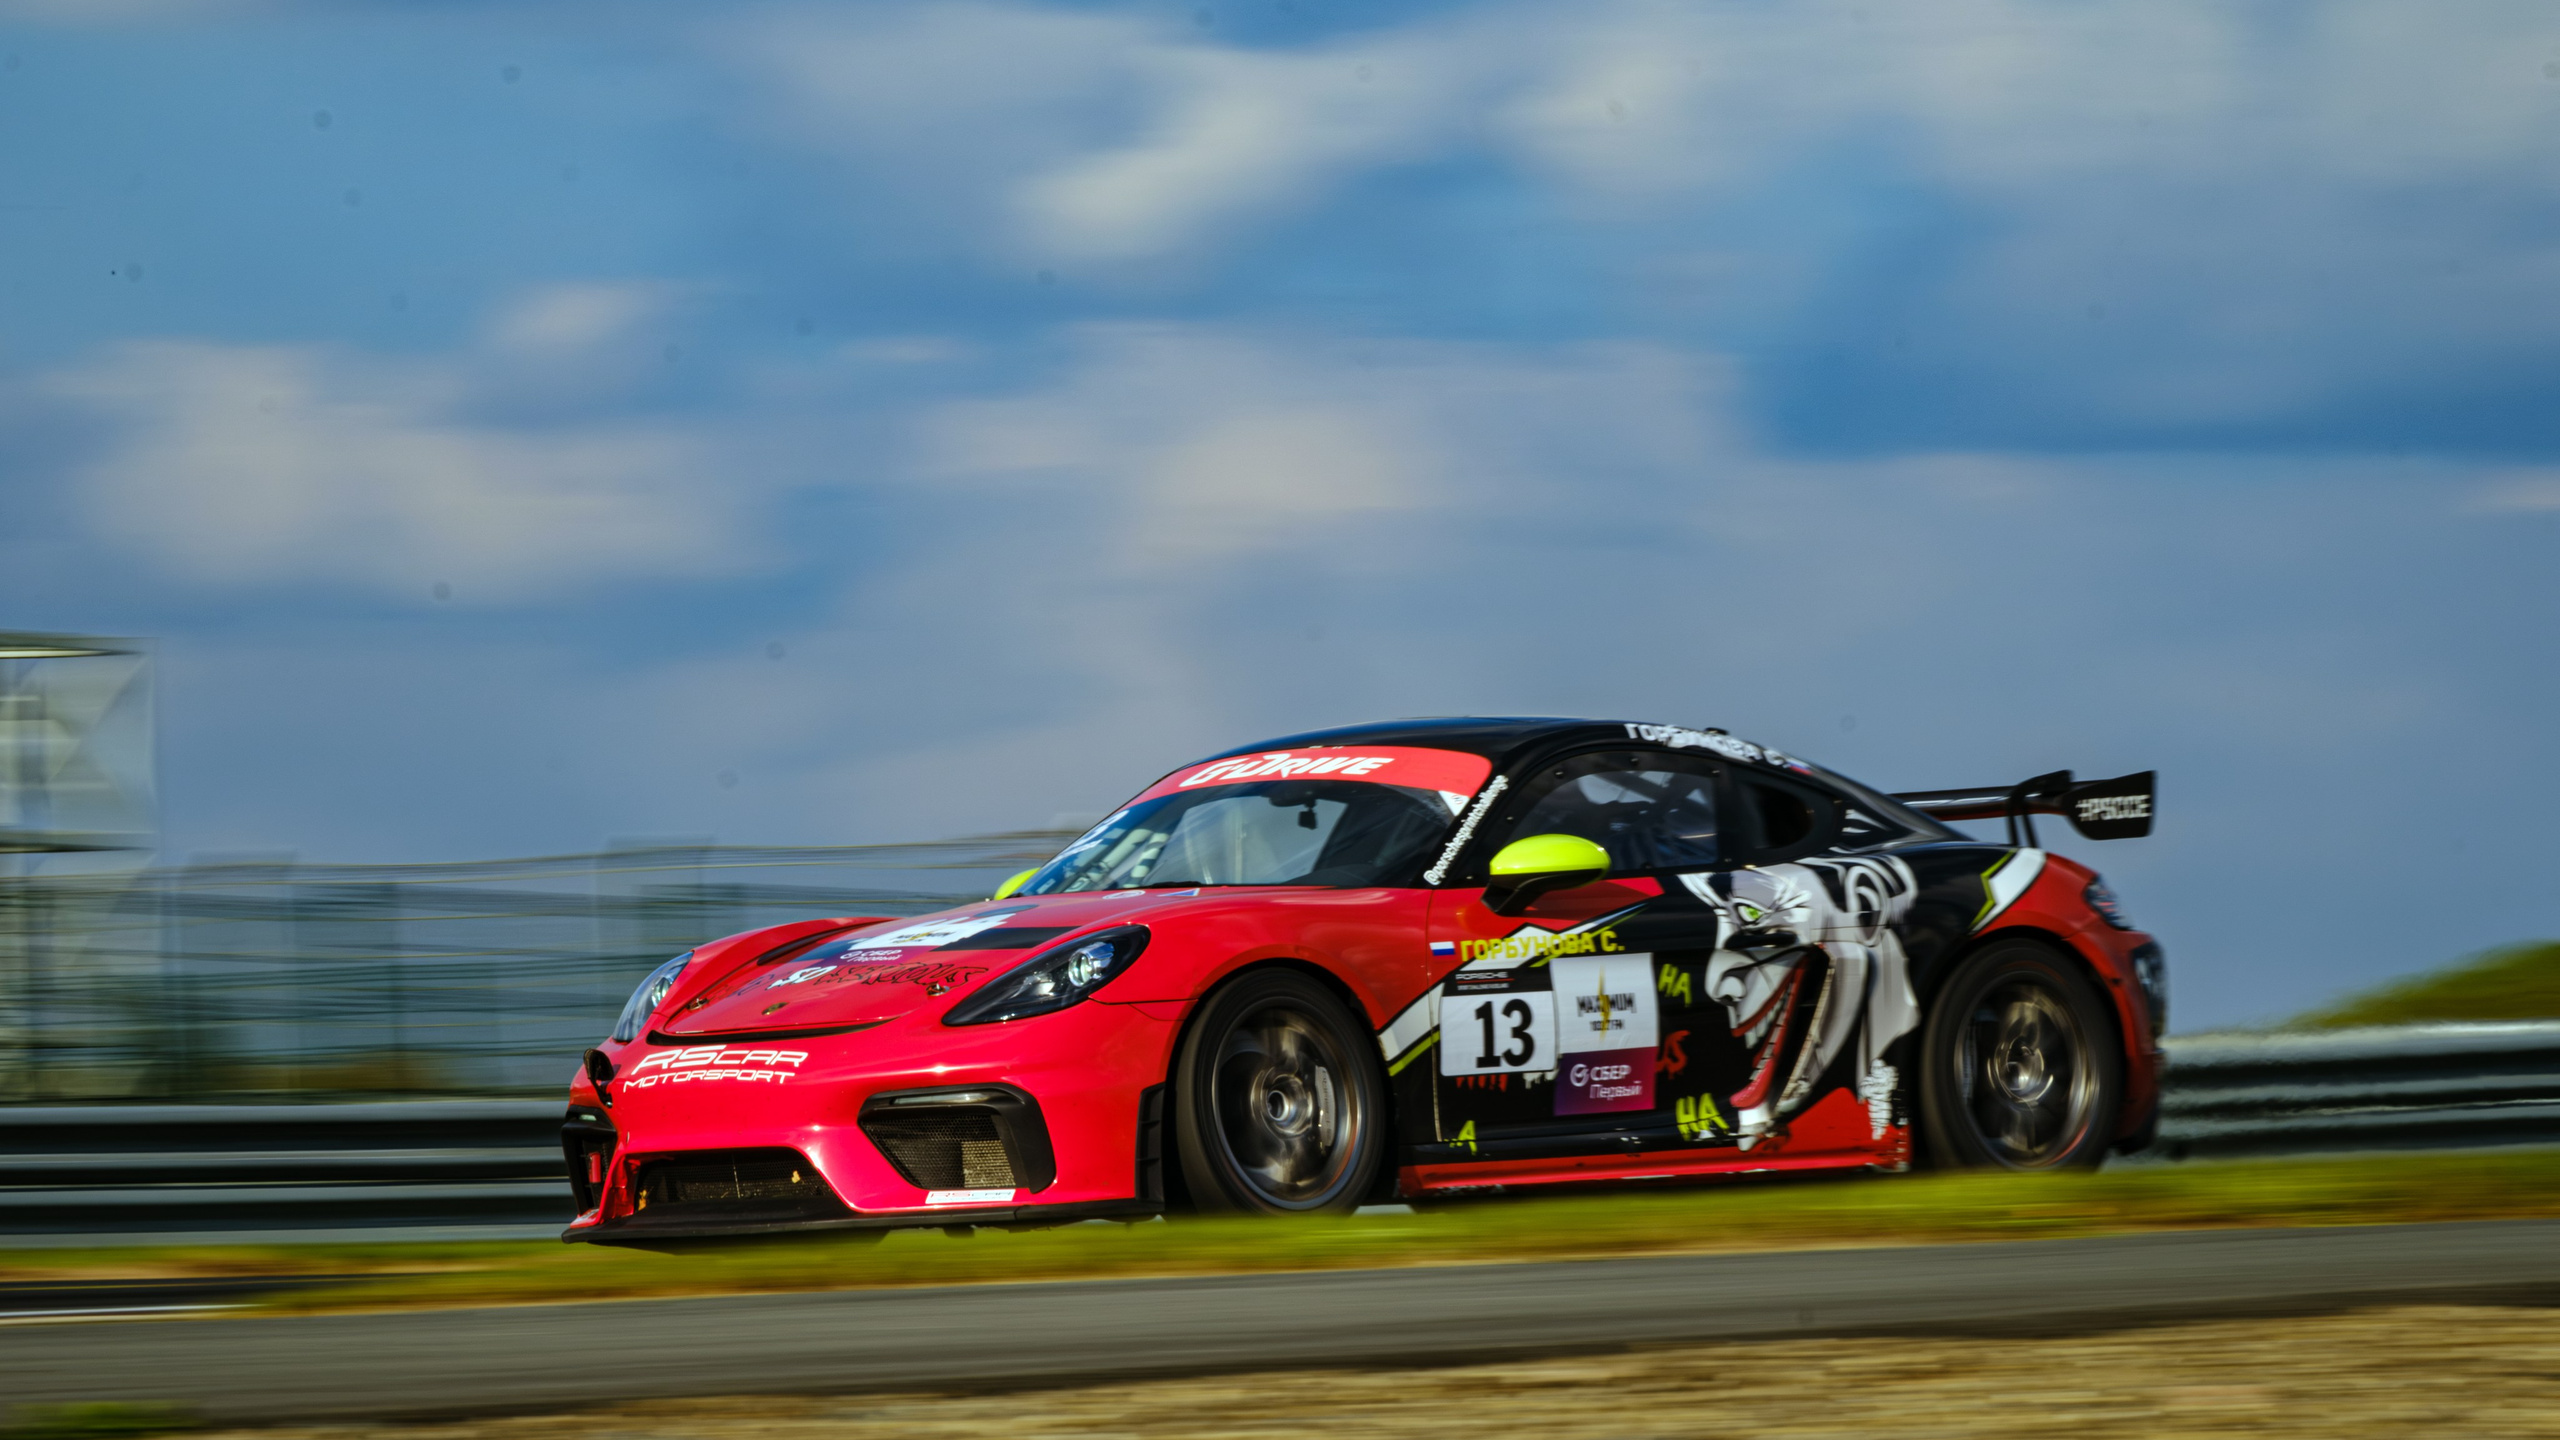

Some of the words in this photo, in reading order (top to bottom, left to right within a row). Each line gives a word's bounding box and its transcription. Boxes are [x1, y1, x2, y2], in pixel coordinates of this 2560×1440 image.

[1460, 932, 1595, 961] ГОРБУНОВА
[1474, 998, 1536, 1069] 13
[623, 1069, 795, 1092] MOTORSPORT
[1590, 1064, 1631, 1081] СБЕР
[1590, 1080, 1642, 1100] Первый
